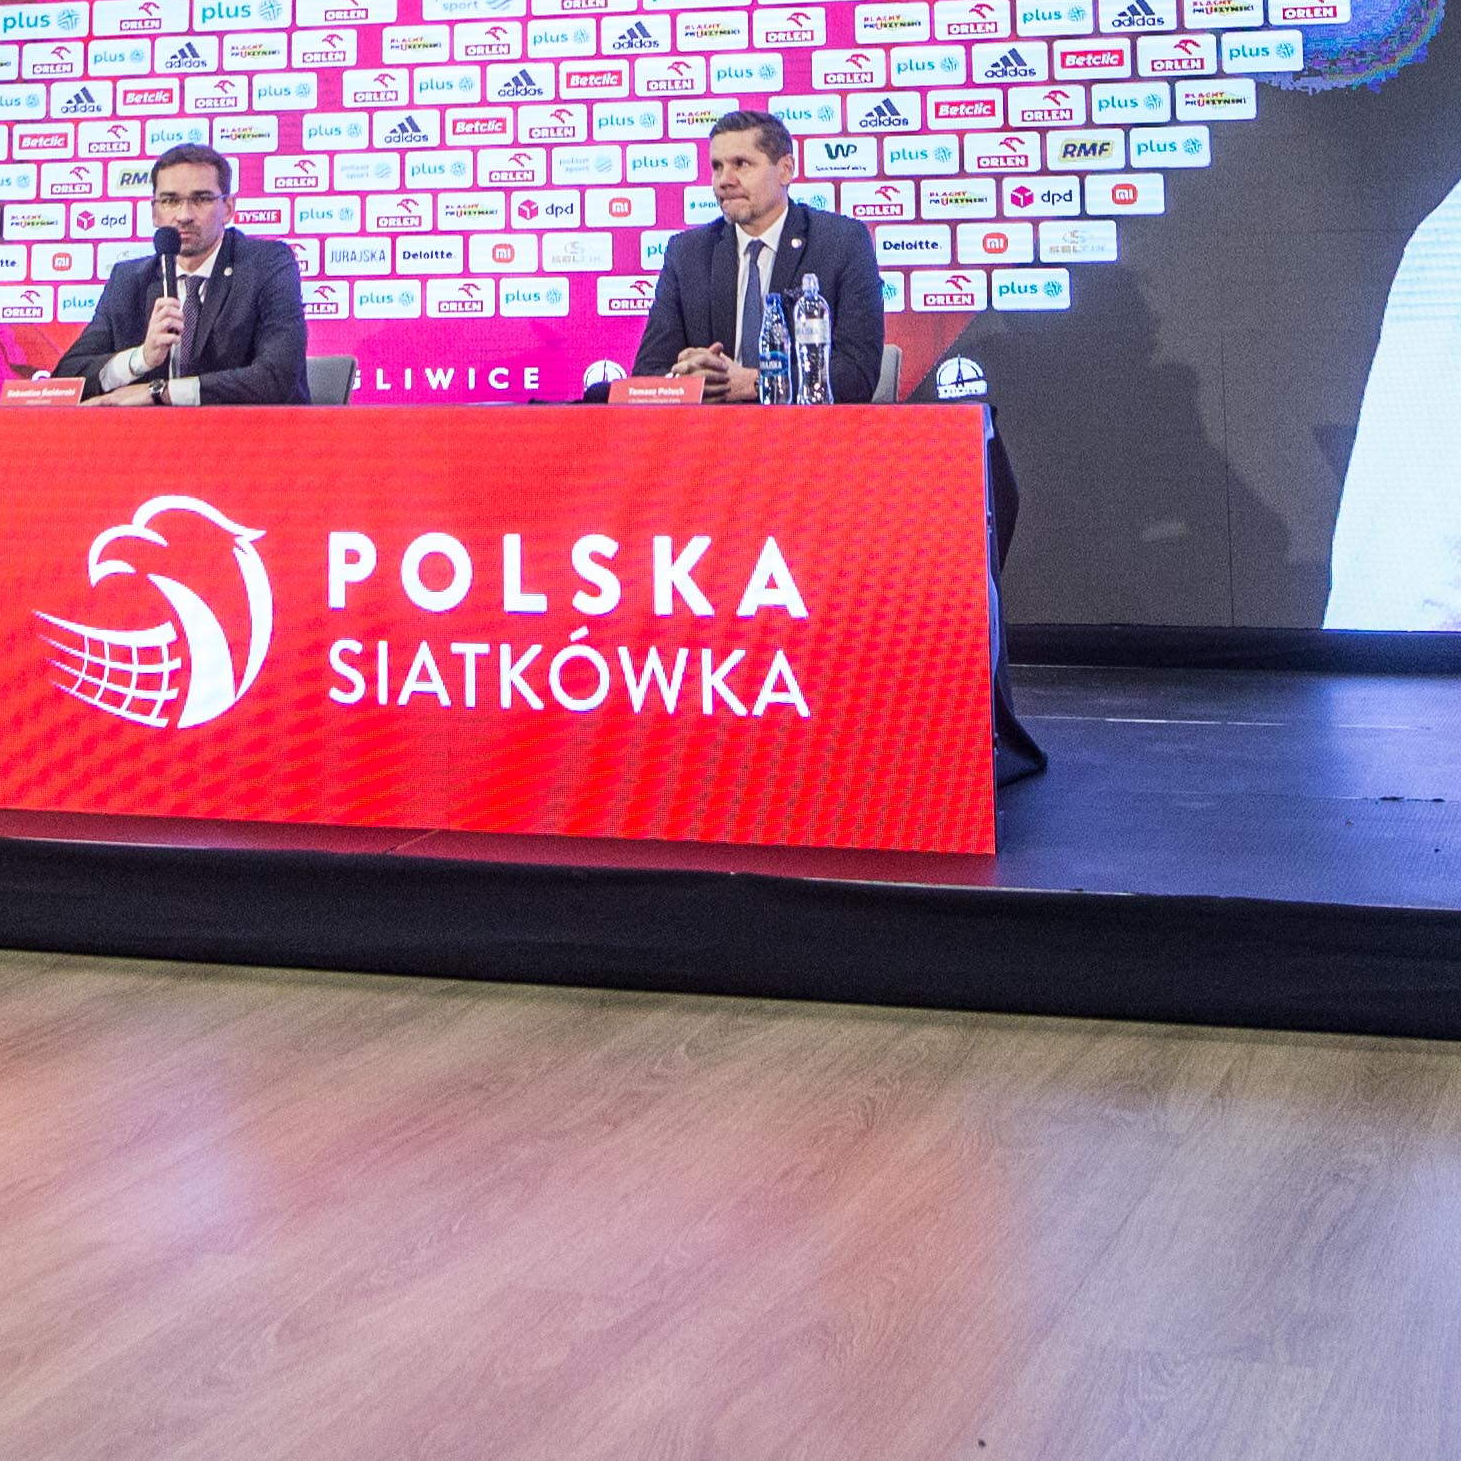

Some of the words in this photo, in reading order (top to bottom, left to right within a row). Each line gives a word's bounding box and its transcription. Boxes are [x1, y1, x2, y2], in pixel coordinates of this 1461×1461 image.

[201, 0, 251, 24] plus
[325, 9, 368, 21] ORLEN
[1023, 7, 1061, 24] plus
[1283, 6, 1337, 19] ORLEN
[2, 10, 50, 32] plus
[120, 19, 161, 30] ORLEN
[948, 22, 997, 34] ORLEN
[1112, 15, 1164, 28] adidas
[533, 30, 568, 46] plus
[766, 30, 814, 42] ORLEN
[465, 44, 510, 55] ORLEN
[613, 38, 659, 50] adidas
[93, 49, 125, 65] plus
[303, 50, 346, 62] ORLEN
[1063, 51, 1122, 67] Betclic
[1229, 43, 1269, 61] plus
[33, 62, 73, 73] ORLEN
[165, 57, 207, 69] adidas
[897, 57, 935, 74] plus
[1152, 58, 1204, 71] ORLEN
[717, 65, 754, 81] plus
[824, 72, 873, 84] ORLEN
[985, 65, 1036, 78] adidas
[419, 78, 453, 94] plus
[567, 72, 618, 88] Betclic
[646, 79, 693, 91] ORLEN
[124, 89, 172, 104] Betclic
[258, 83, 290, 99] plus
[354, 90, 398, 102] ORLEN
[498, 85, 543, 97] adidas
[60, 102, 102, 114] adidas
[195, 97, 236, 108] ORLEN
[938, 101, 992, 117] Betclic
[1098, 94, 1138, 111] plus
[598, 113, 634, 129] plus
[859, 115, 909, 127] adidas
[1022, 109, 1071, 121] ORLEN
[308, 124, 342, 139] plus
[453, 120, 503, 134] Betclic
[529, 126, 575, 138] ORLEN
[19, 134, 68, 149] Betclic
[150, 128, 183, 144] plus
[384, 132, 428, 143] adidas
[89, 141, 130, 153] ORLEN
[1137, 138, 1178, 155] plus
[890, 146, 928, 163] plus
[411, 161, 445, 176] plus
[632, 155, 668, 170] plus
[978, 156, 1028, 168] ORLEN
[275, 177, 318, 187] ORLEN
[490, 170, 533, 181] ORLEN
[51, 183, 91, 194] ORLEN
[1041, 188, 1072, 204] dpd
[239, 210, 277, 223] TYSKIE
[299, 206, 333, 222] plus
[546, 202, 573, 217] dpd
[854, 204, 902, 216] ORLEN
[101, 213, 127, 229] dpd
[378, 216, 421, 227] ORLEN
[330, 249, 385, 264] JURAJSKA
[998, 280, 1038, 296] plus
[62, 296, 95, 310] plus
[360, 291, 393, 306] plus
[505, 290, 540, 304] plus
[925, 294, 974, 305] ORLEN
[3, 307, 42, 317] ORLEN
[439, 301, 482, 311] ORLEN
[328, 531, 808, 618] POLSKA
[328, 626, 810, 717] SIATKÓWKA
